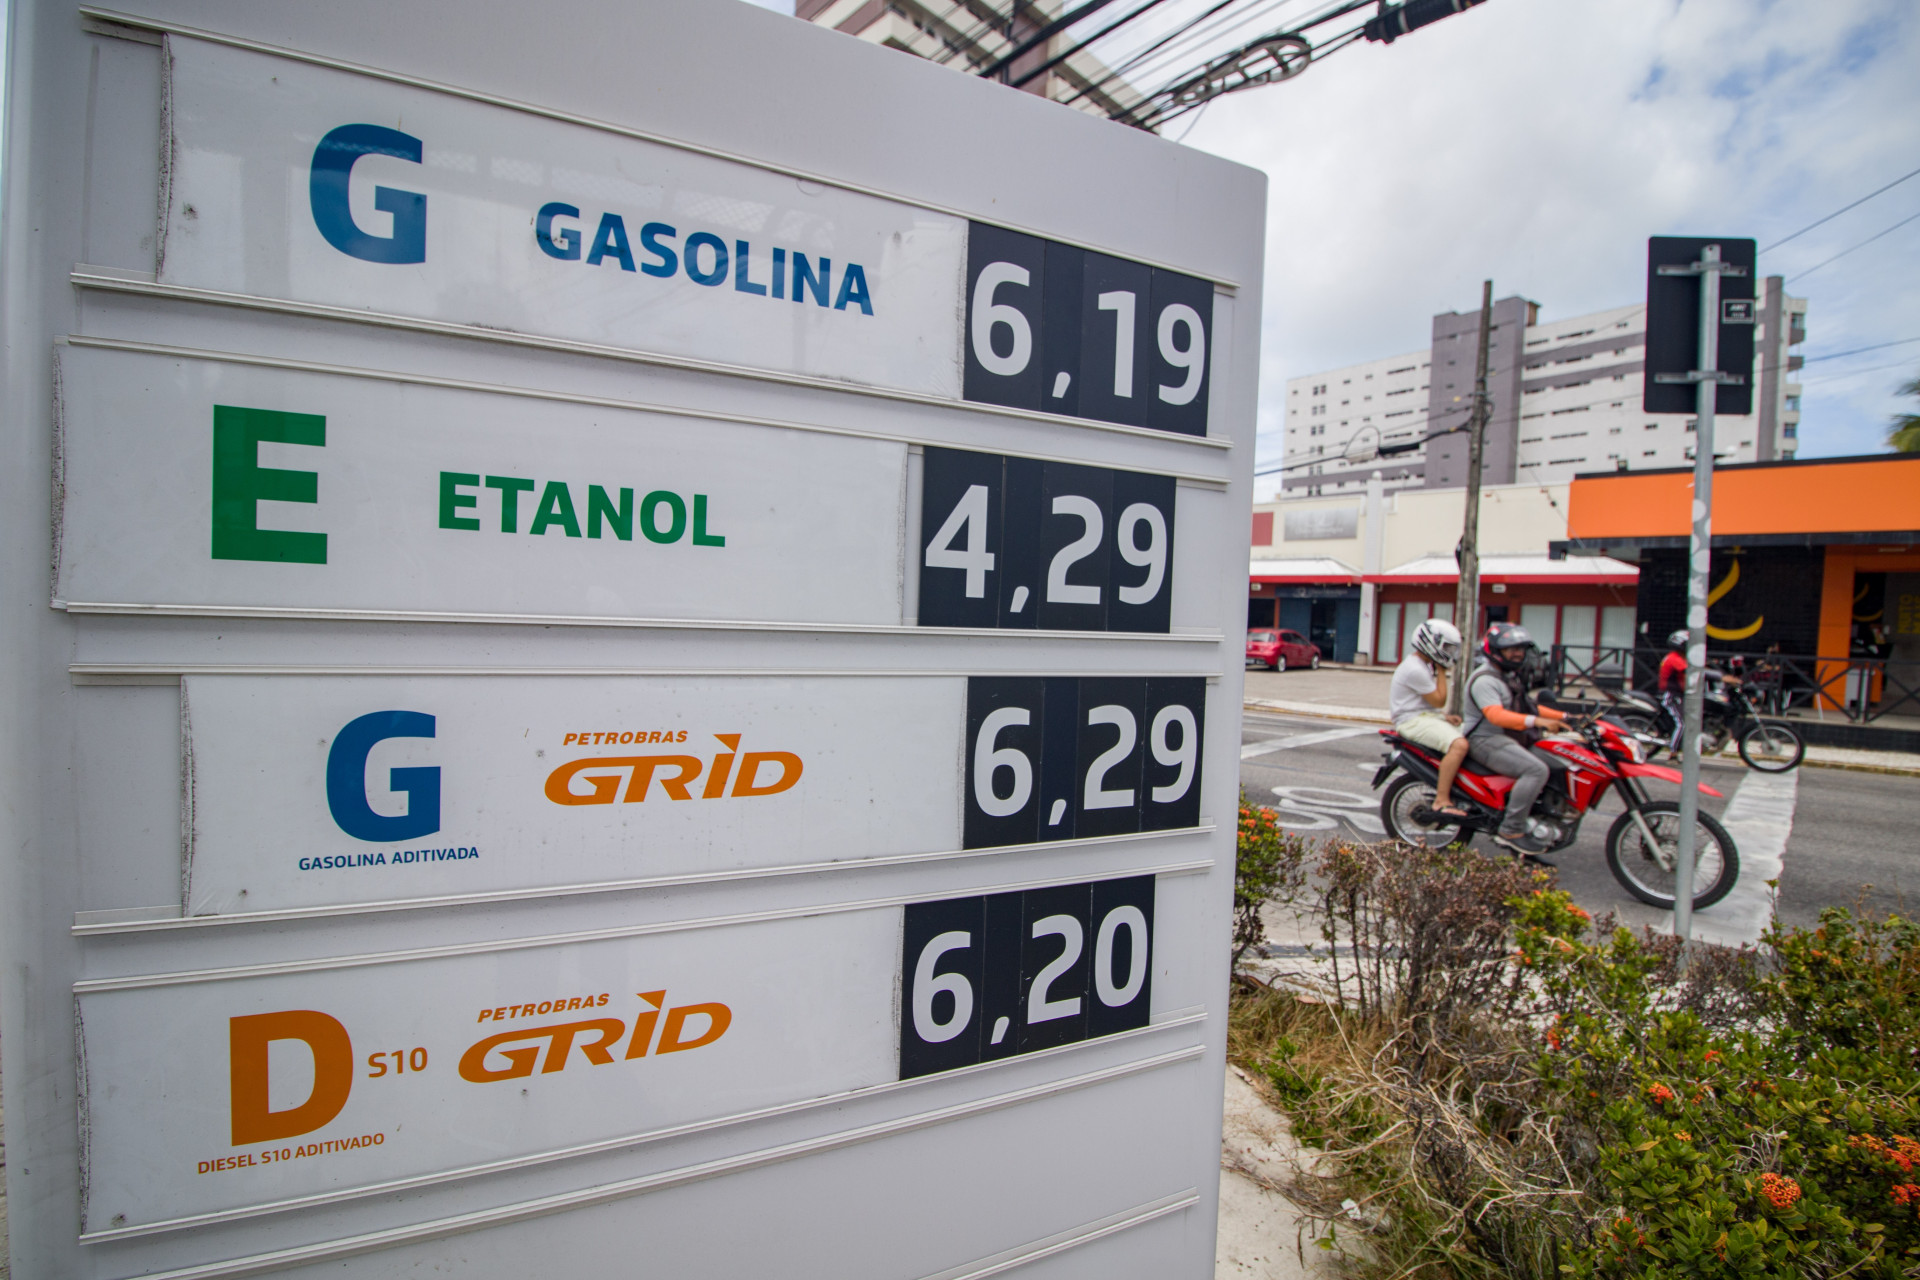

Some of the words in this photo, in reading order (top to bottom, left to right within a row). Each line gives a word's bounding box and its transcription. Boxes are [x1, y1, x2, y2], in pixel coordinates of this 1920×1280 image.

[309, 123, 426, 264] G
[536, 202, 873, 316] GASOLINA
[971, 261, 1206, 406] 6,19
[211, 404, 327, 565] E
[439, 471, 725, 548] ETANOL
[925, 484, 1168, 613] 4,29
[326, 710, 441, 842] G
[563, 730, 688, 746] PETROBRAS
[973, 704, 1198, 826] 6,29
[299, 853, 387, 871] GASOLINA
[391, 846, 479, 864] ADITIVADA
[477, 992, 610, 1023] PETROBRAS
[912, 905, 1148, 1045] 6,20
[229, 1010, 354, 1147] D
[368, 1047, 428, 1078] S10
[198, 1154, 257, 1175] DIESEL
[261, 1148, 291, 1165] S10
[295, 1133, 385, 1159] ADITIVADO
